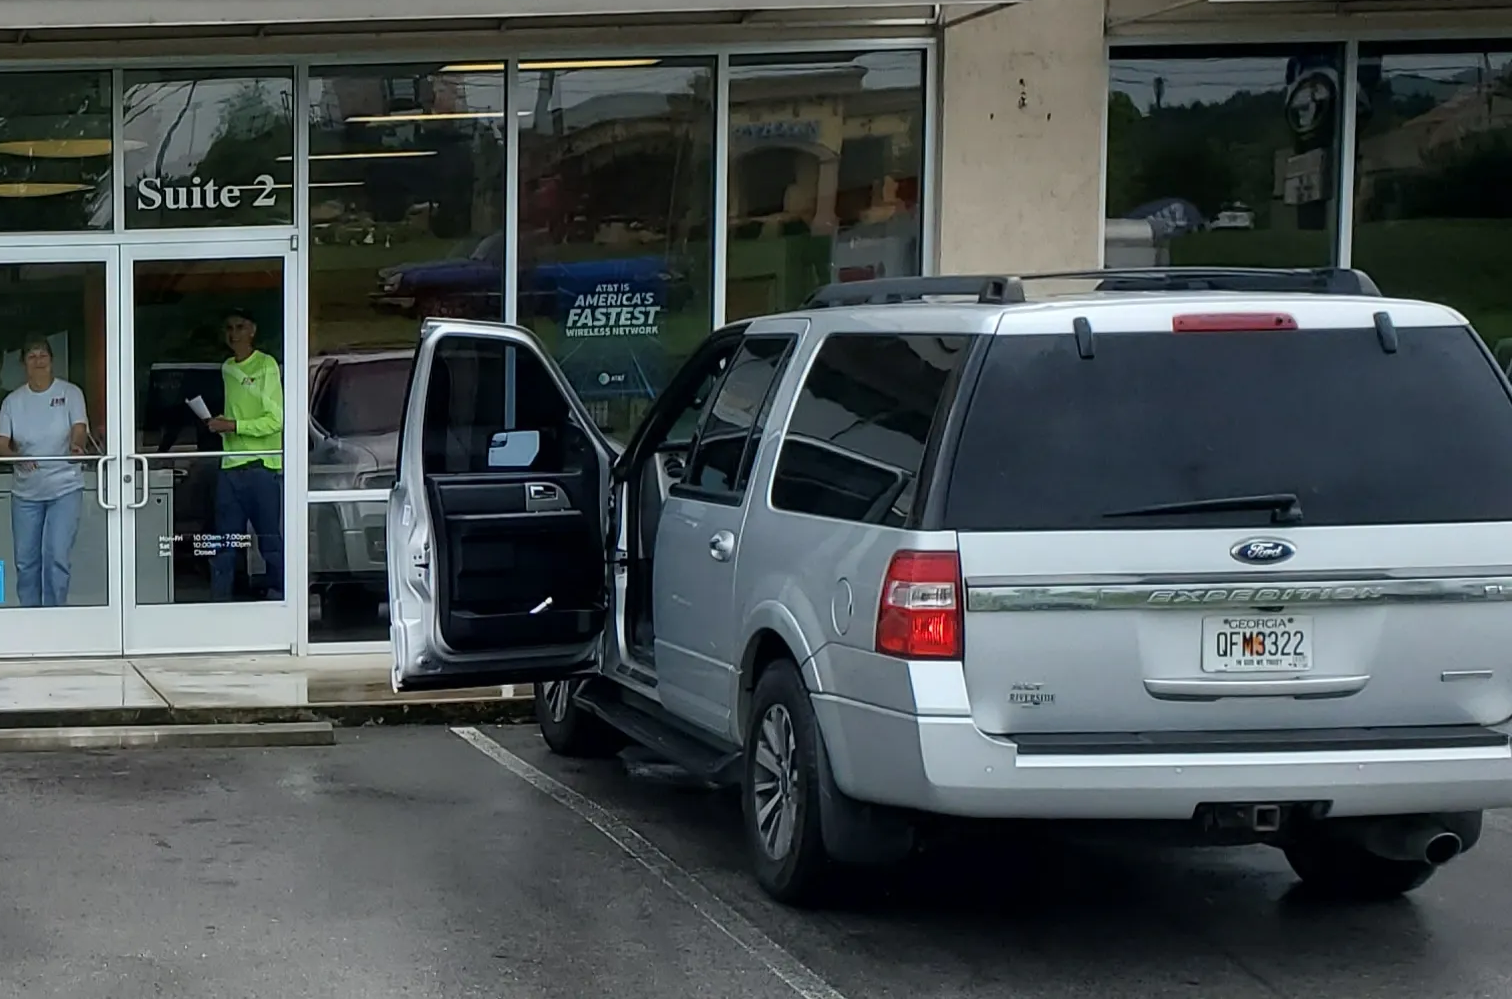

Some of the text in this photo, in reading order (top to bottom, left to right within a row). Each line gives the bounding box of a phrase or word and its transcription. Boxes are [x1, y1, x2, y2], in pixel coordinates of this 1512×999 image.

[137, 174, 277, 210] Suite 2
[595, 283, 630, 292] AT&T IS
[574, 292, 655, 307] AMERICA'S
[566, 306, 661, 327] FASTEST
[566, 326, 659, 337] WIRELESS NETWORK
[1146, 586, 1385, 603] EXPEDITION
[1228, 618, 1287, 630] GEORGIA
[1216, 630, 1304, 657] QFM3322
